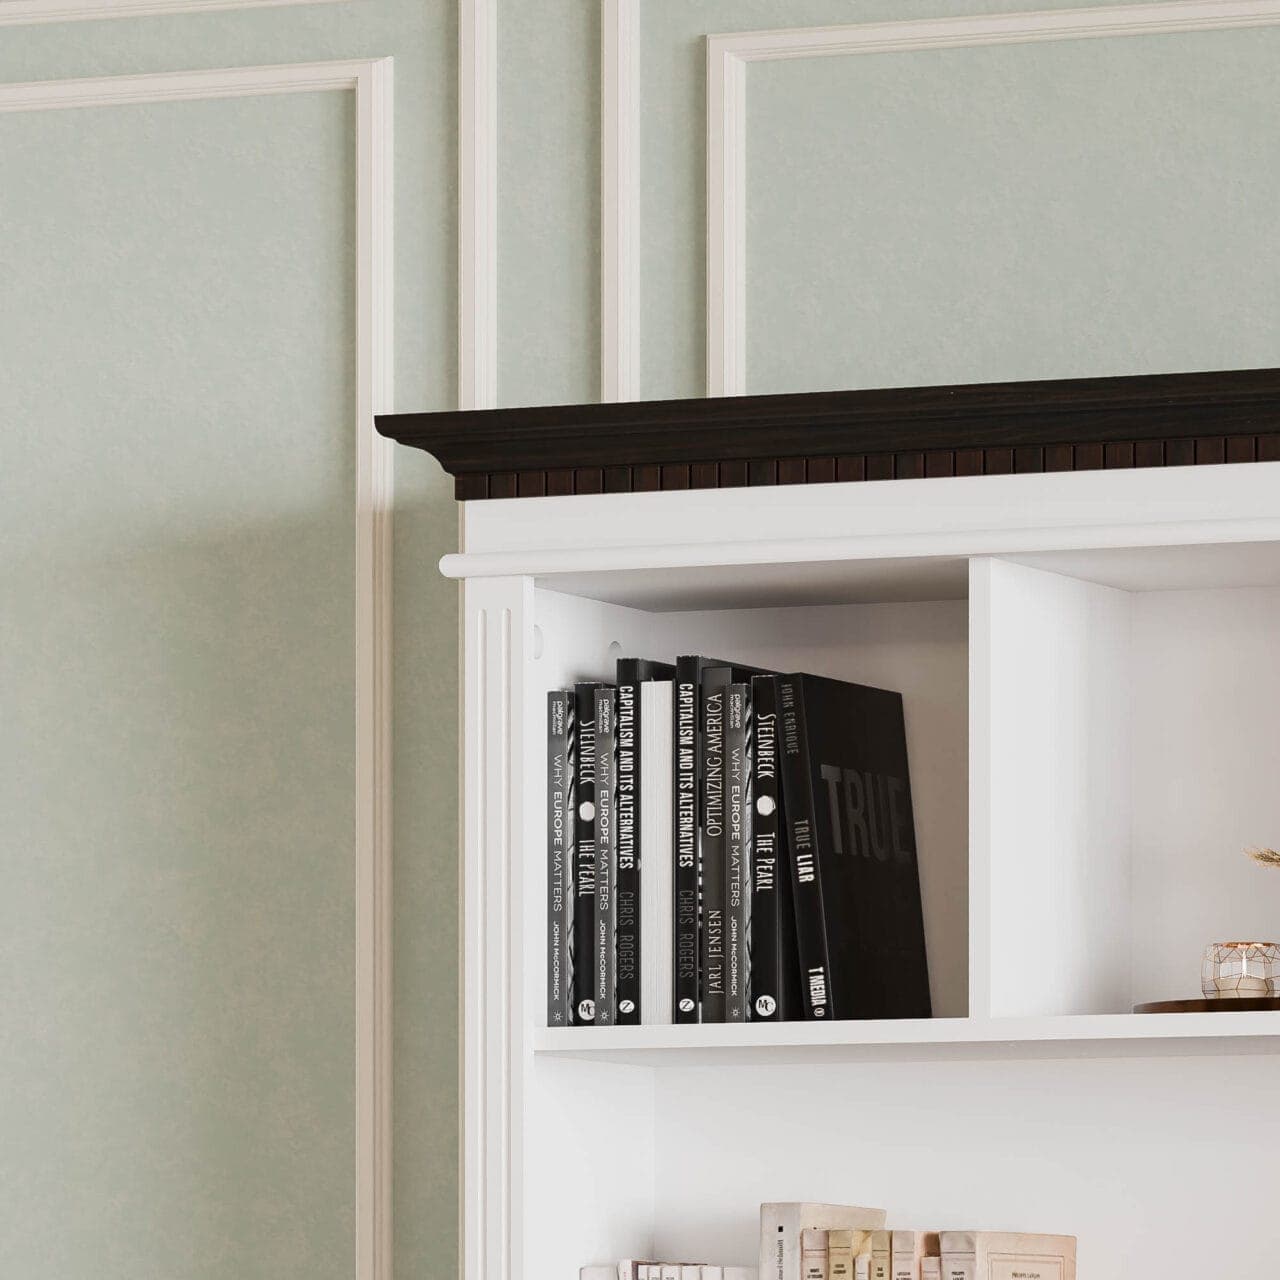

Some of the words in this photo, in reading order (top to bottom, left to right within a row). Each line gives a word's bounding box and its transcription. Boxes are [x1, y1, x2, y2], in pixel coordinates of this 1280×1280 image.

[602, 699, 610, 733] palgrave
[679, 683, 694, 745] CAPITALISM
[733, 694, 741, 728] palgrave
[780, 684, 794, 708] JOHN
[555, 701, 563, 735] palgrave
[619, 686, 633, 748] CAPITALISM
[706, 693, 723, 754] AMERICA
[579, 720, 595, 784] STEINBECK
[619, 751, 633, 771] AND
[679, 748, 694, 769] AND
[731, 748, 741, 781] WHY
[757, 713, 776, 779] STEINBECK
[553, 754, 563, 787] WHY
[600, 752, 609, 785] WHY
[619, 774, 633, 791] ITS
[679, 773, 694, 789] ITS
[706, 756, 723, 836] OPTIMIZING
[731, 785, 741, 840] EUROPE
[820, 764, 912, 864] TRUE
[553, 791, 563, 846] EUROPE
[600, 789, 609, 844] EUROPE
[619, 794, 633, 869] ALTERNATIVES
[679, 793, 694, 868] ALTERNATIVES
[793, 819, 810, 851] TRUE
[553, 850, 563, 912] MATTERS
[579, 862, 595, 897] PEARL
[600, 849, 609, 910] MATTERS
[731, 845, 741, 907] MATTERS
[756, 858, 775, 892] PEARL
[795, 854, 814, 884] LIAR
[619, 891, 634, 926] CHRIS
[679, 890, 694, 924] CHRIS
[708, 910, 724, 959] JENSEN
[730, 916, 738, 941] JOHN
[619, 935, 634, 980] ROGERS
[679, 933, 694, 978] ROGERS
[730, 943, 738, 996] McCORMICK
[708, 964, 724, 995] JARL
